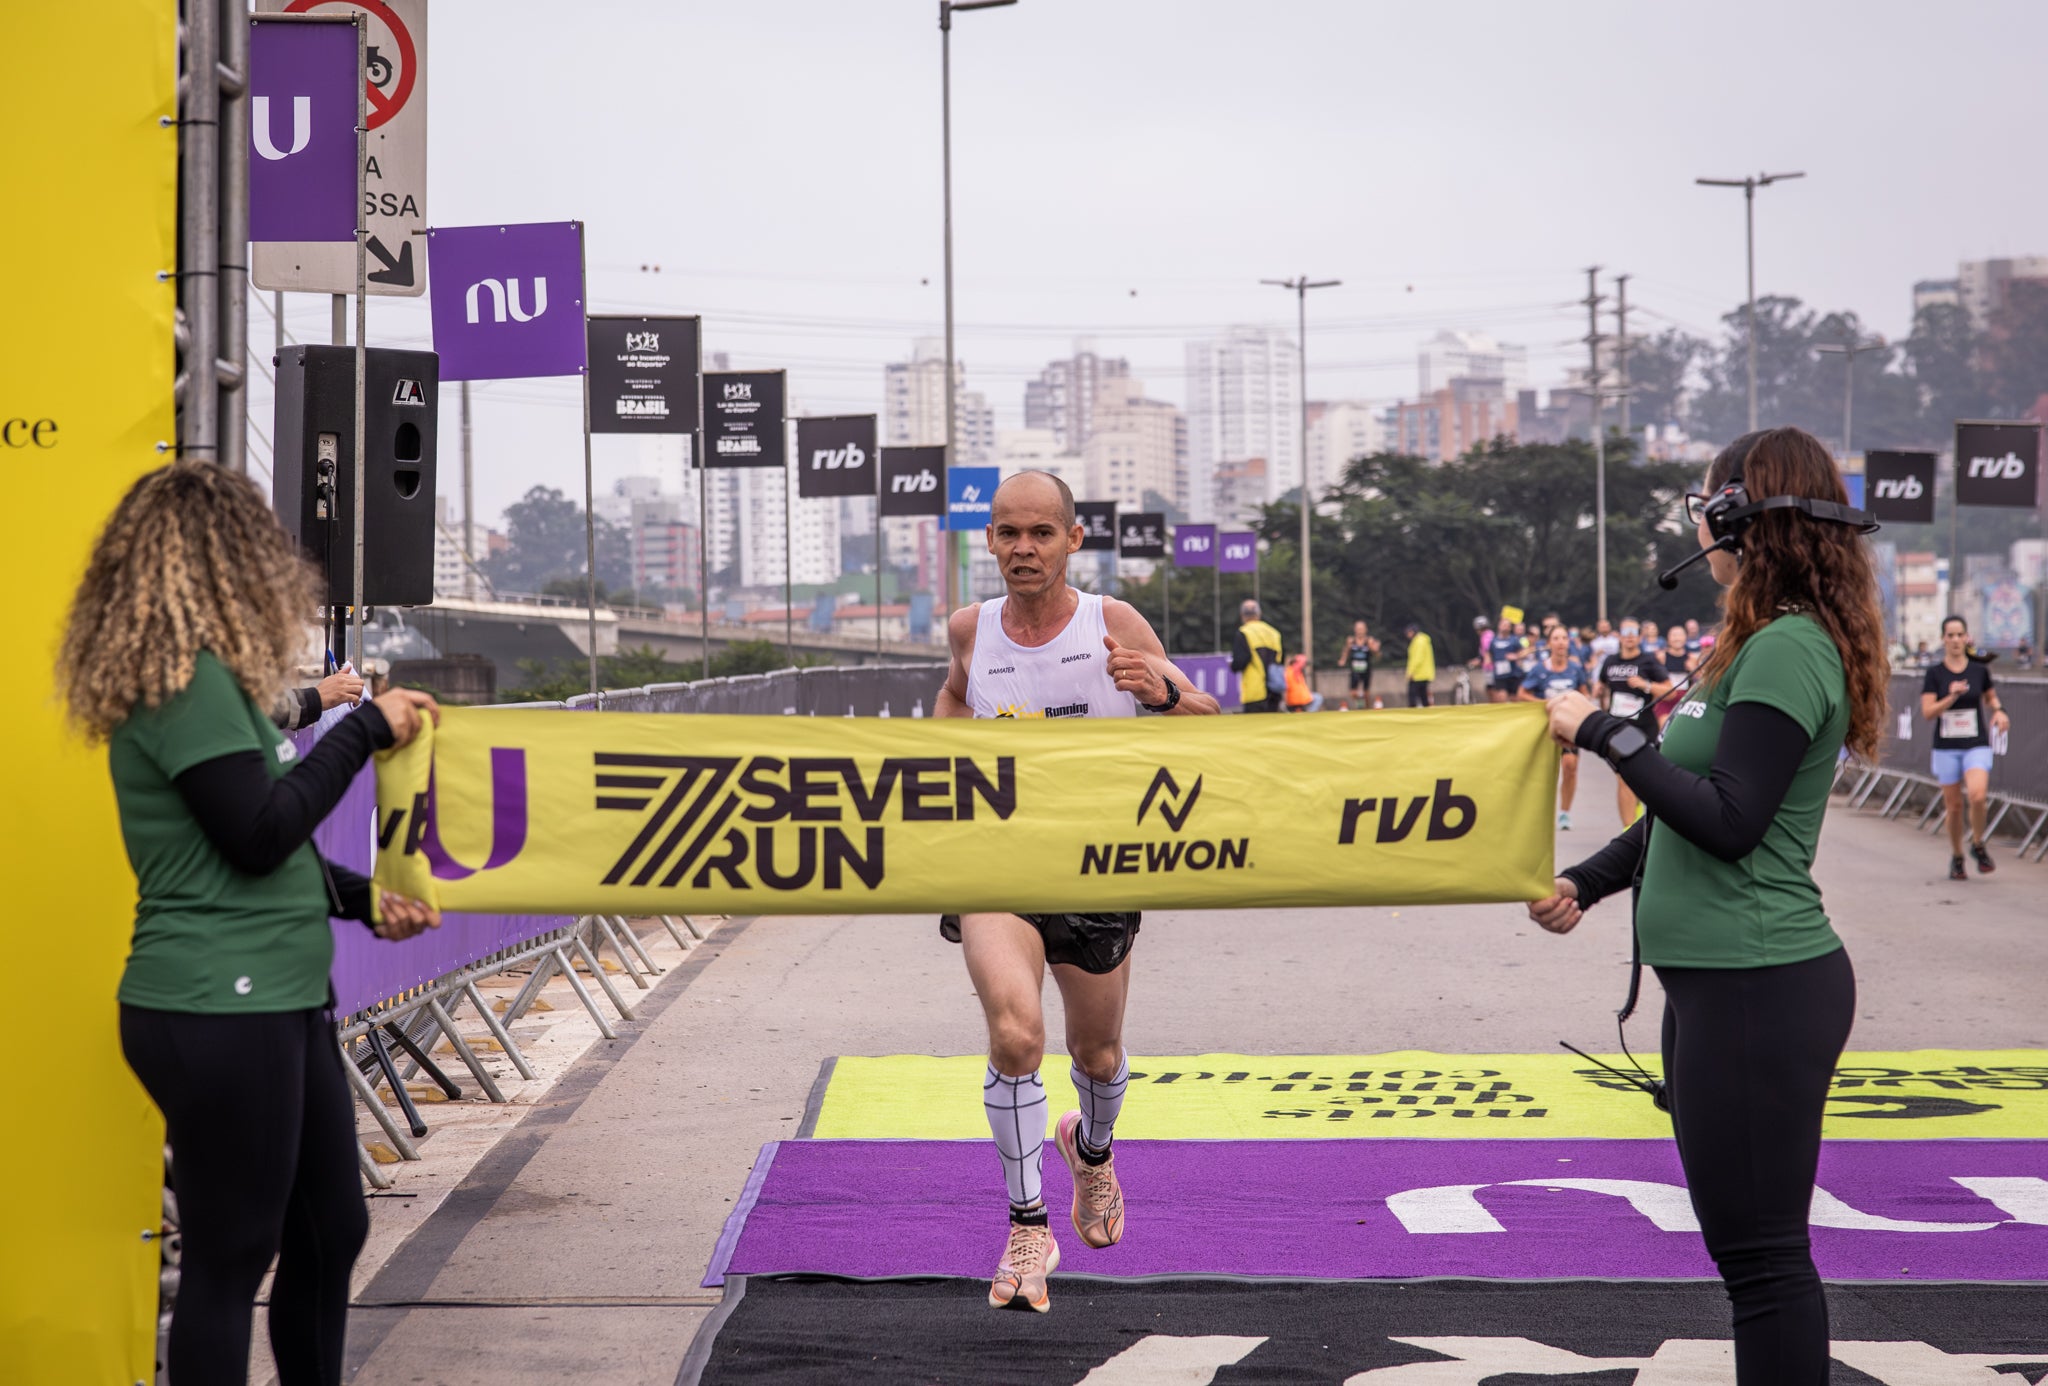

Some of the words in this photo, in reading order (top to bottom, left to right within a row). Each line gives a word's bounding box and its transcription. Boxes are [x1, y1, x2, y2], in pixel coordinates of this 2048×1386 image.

[616, 400, 669, 415] BRASIL
[0, 417, 59, 449] ce
[812, 442, 865, 470] rvb
[1967, 452, 2025, 479] rvb
[891, 469, 938, 493] rvb
[1874, 475, 1924, 499] rvb
[1045, 703, 1089, 718] Running
[1338, 778, 1477, 845] rvb
[692, 826, 885, 890] RUN
